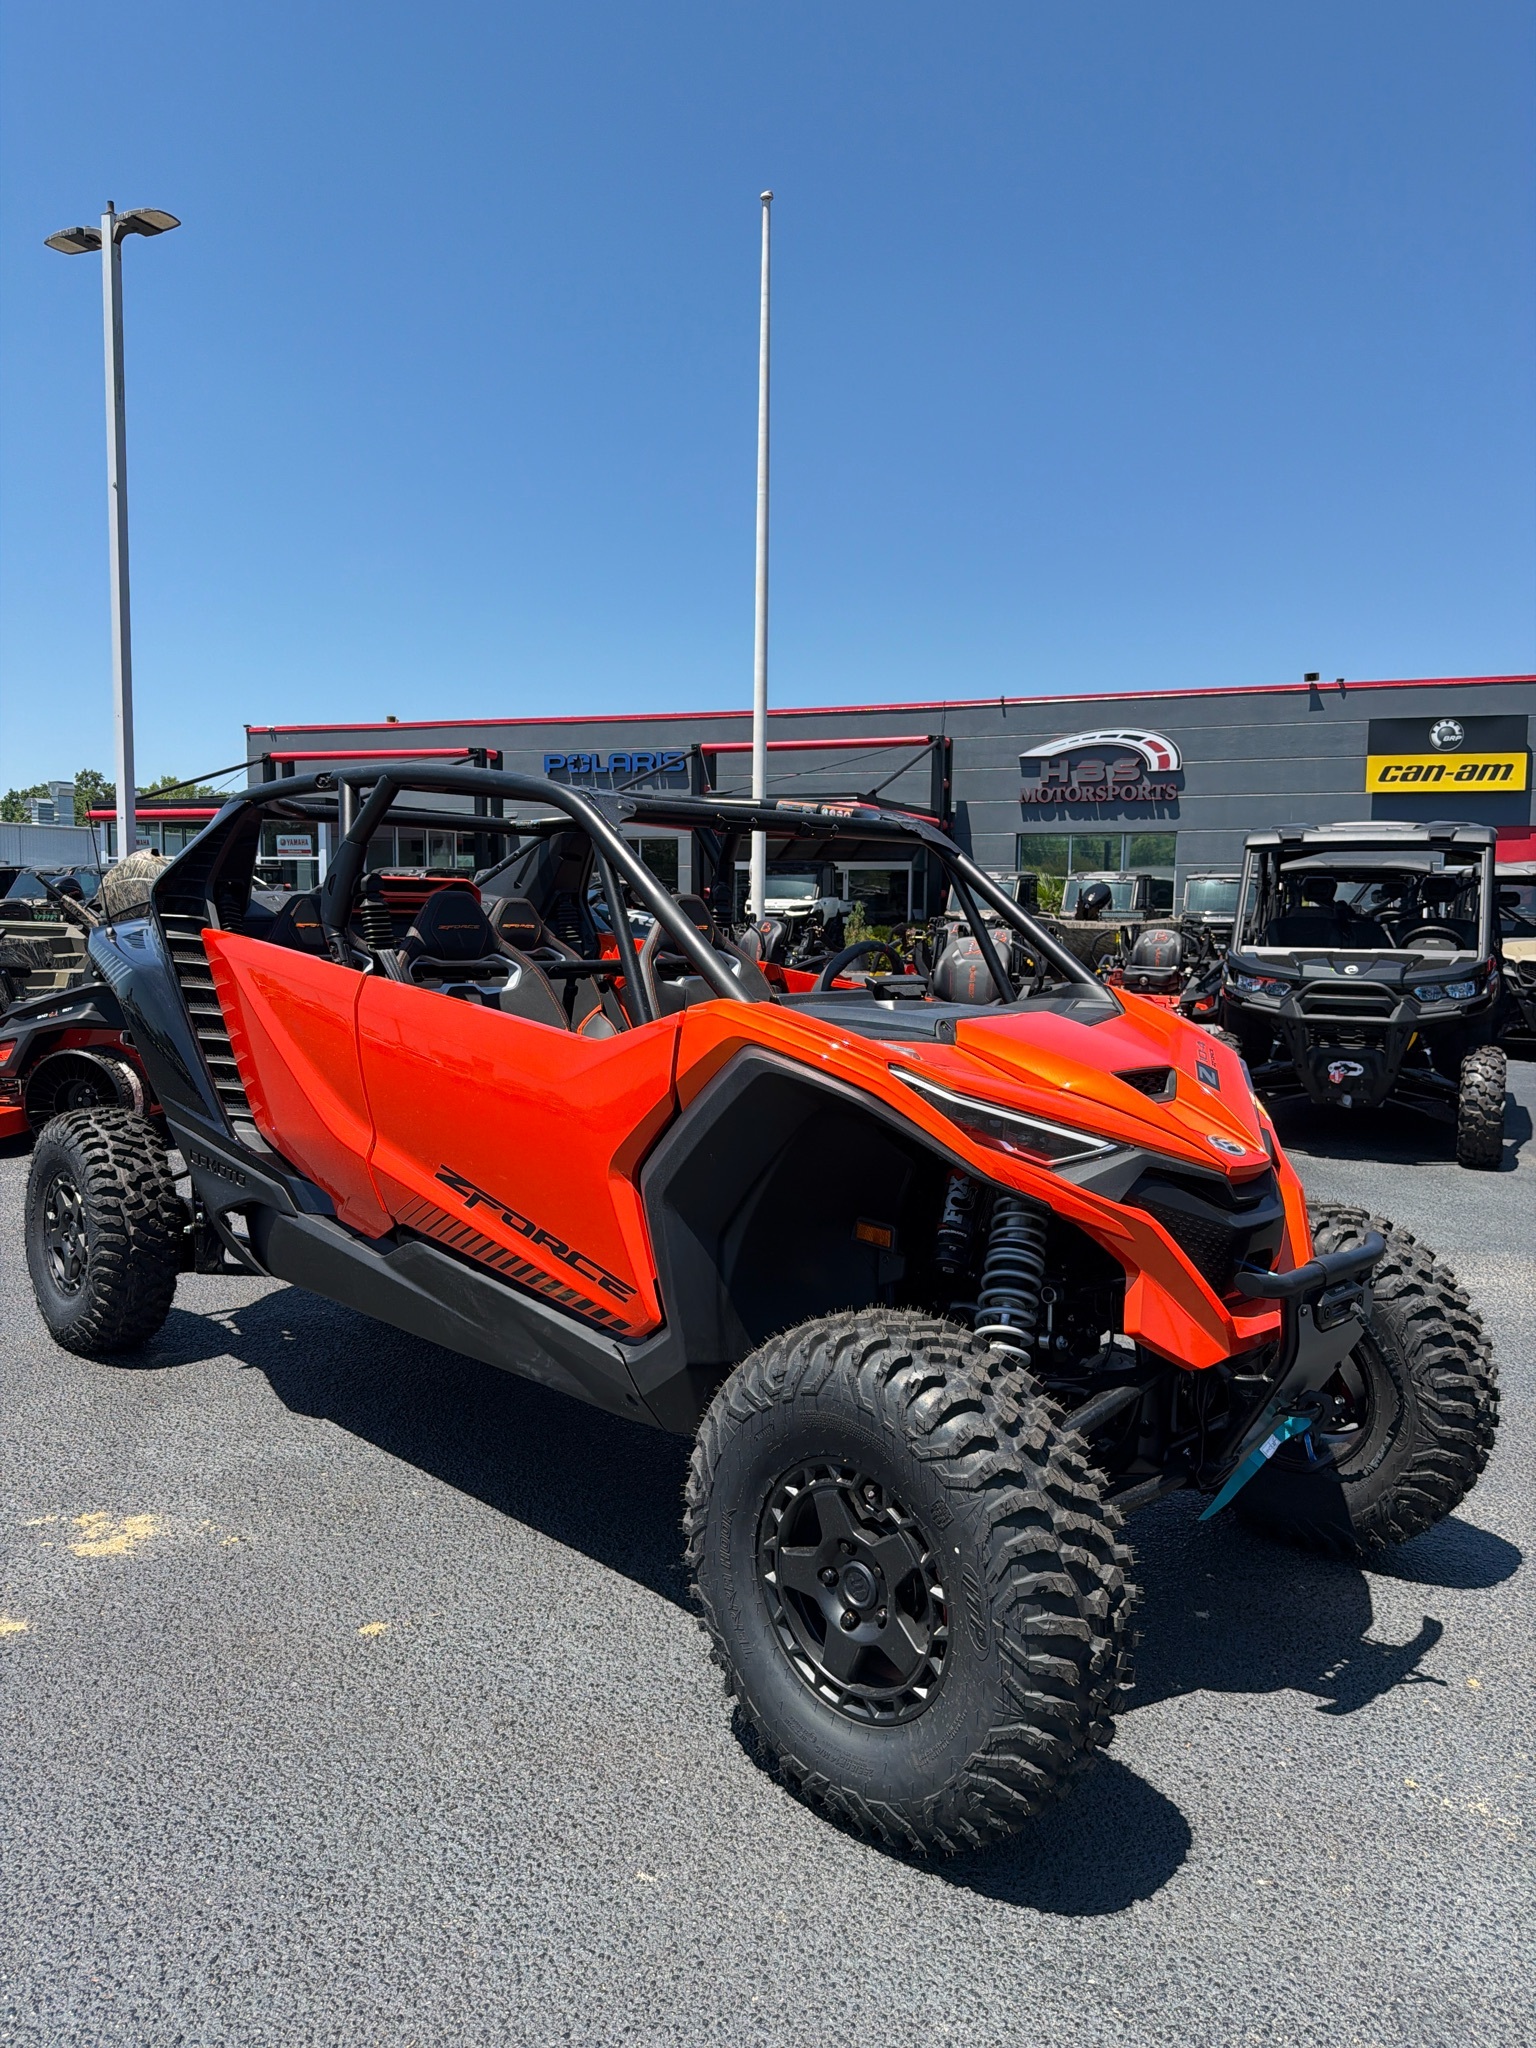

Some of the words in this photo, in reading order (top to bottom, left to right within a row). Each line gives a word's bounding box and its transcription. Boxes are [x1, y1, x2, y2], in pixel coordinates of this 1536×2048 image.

[544, 752, 685, 773] POLARIS
[1040, 757, 1141, 784] HBS
[1020, 784, 1178, 803] MOTORSPORTS
[287, 838, 309, 846] YAMAHA
[190, 1149, 246, 1188] CFMOTO
[943, 1176, 970, 1224] FOX
[434, 1164, 638, 1303] ZFORCE
